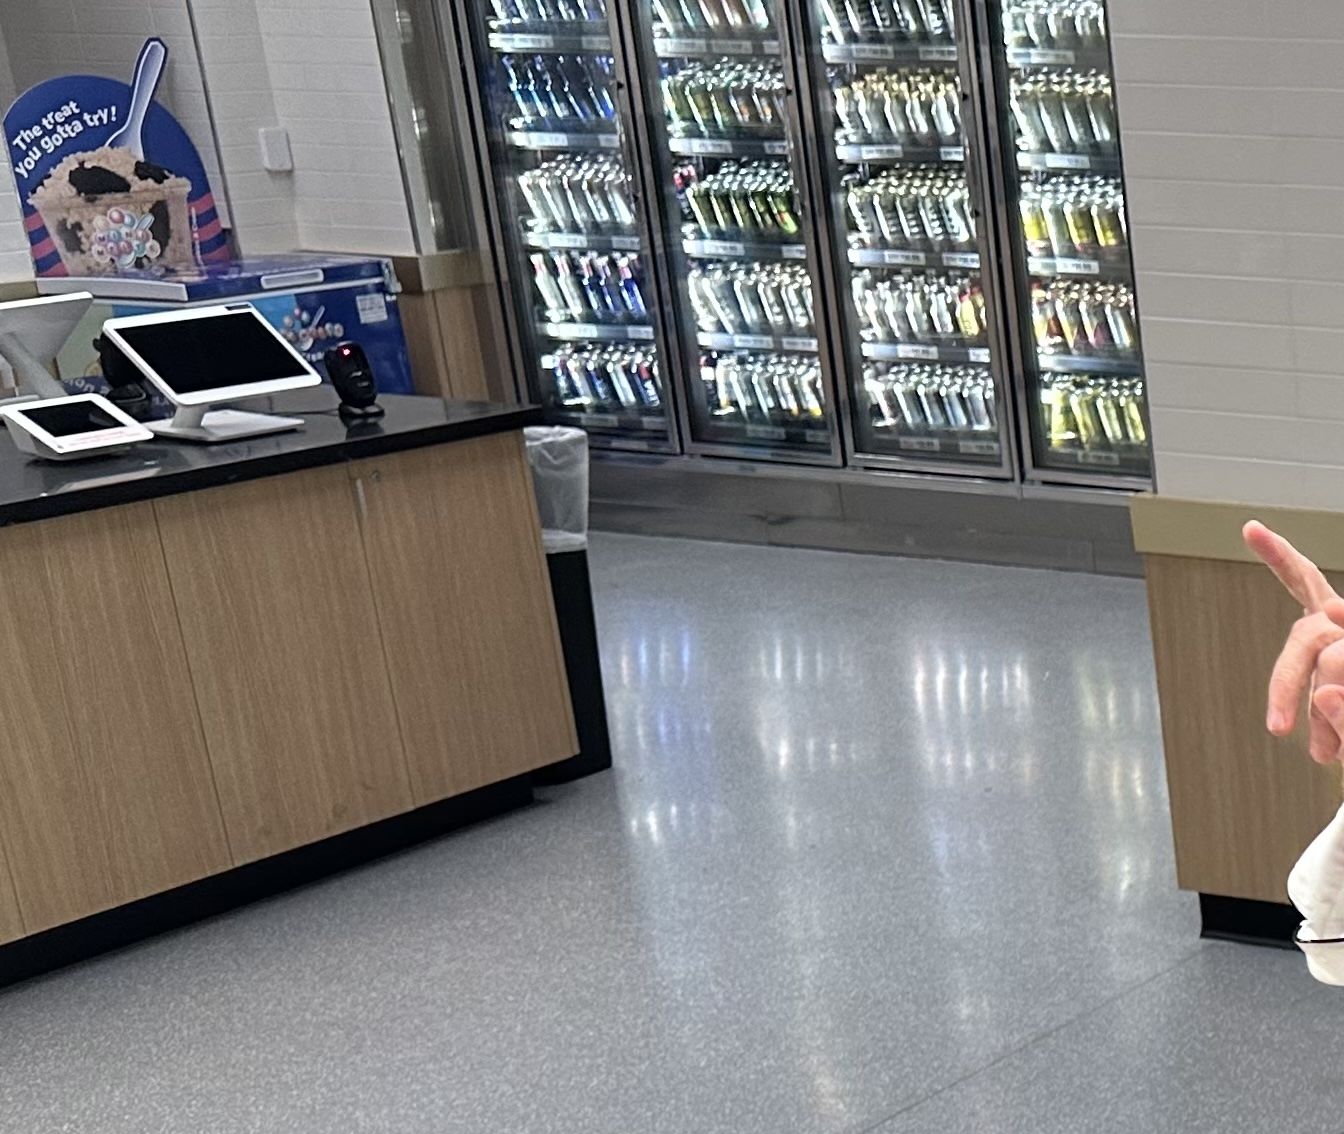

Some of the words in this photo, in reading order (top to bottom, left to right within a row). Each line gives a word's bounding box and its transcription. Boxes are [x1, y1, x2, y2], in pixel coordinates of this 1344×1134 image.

[12, 124, 43, 151] The
[41, 100, 81, 130] treat
[14, 145, 43, 179] you
[40, 119, 84, 154] gotta
[82, 104, 117, 128] try!
